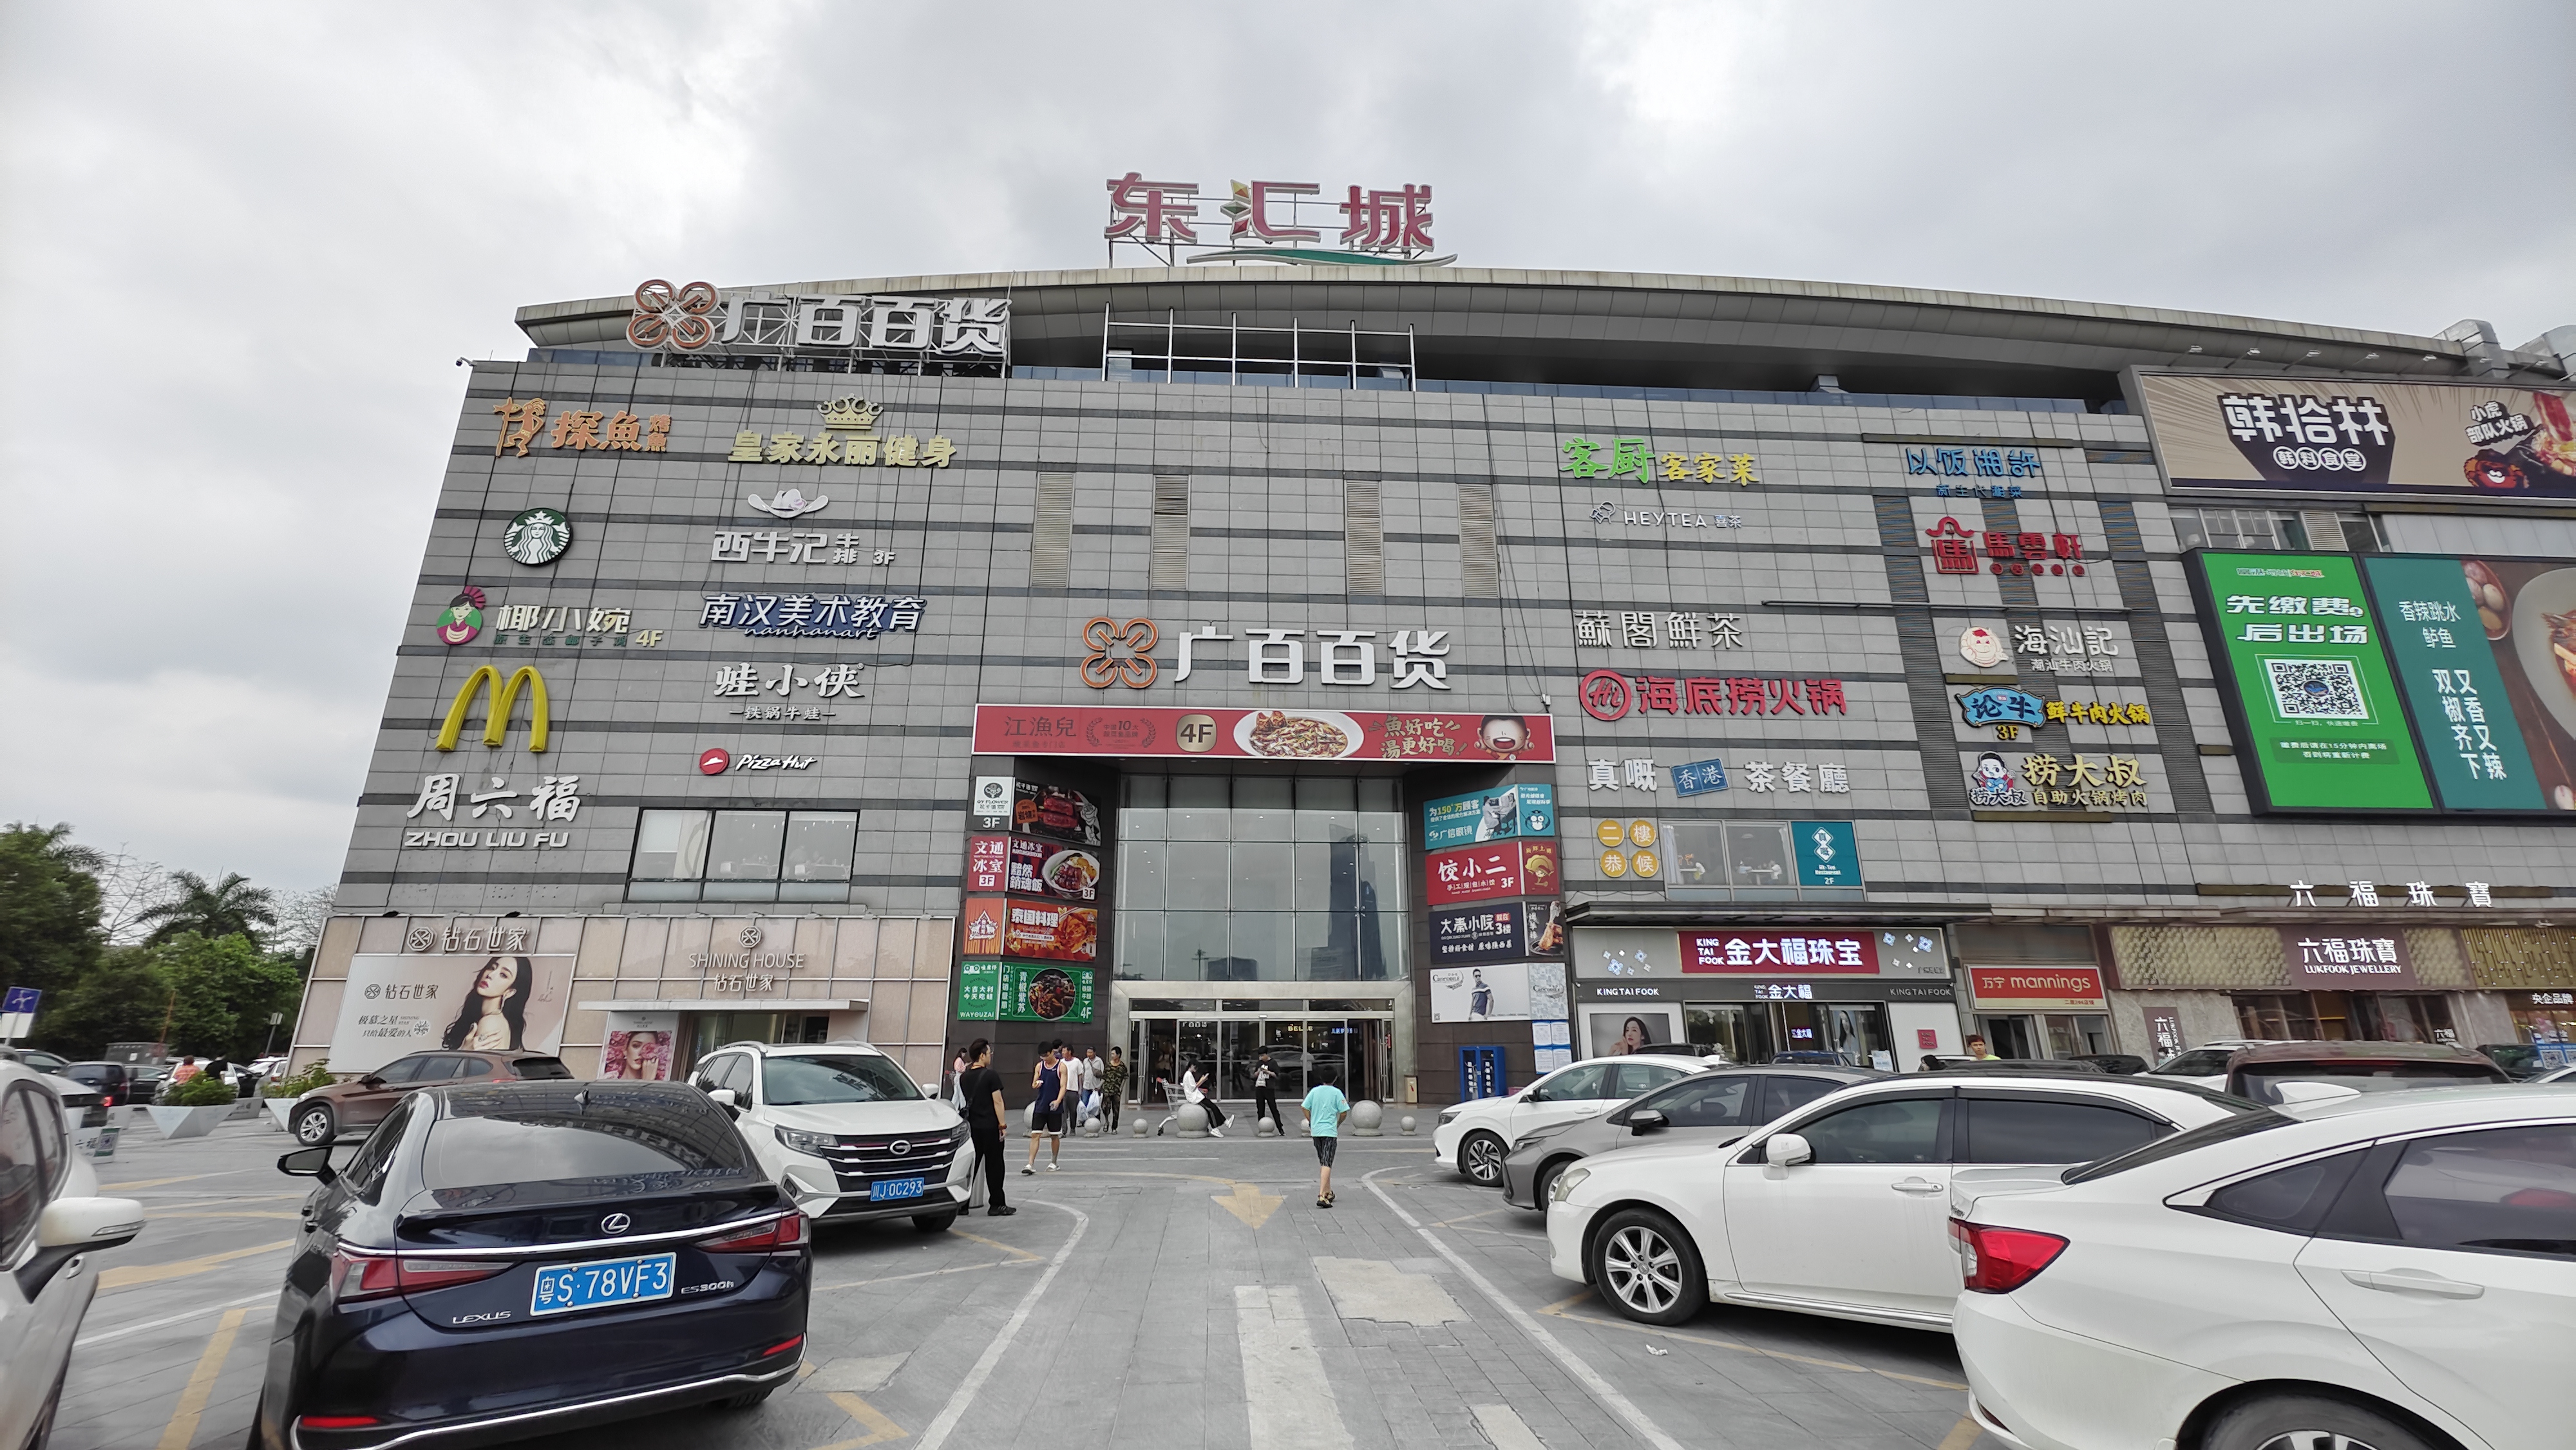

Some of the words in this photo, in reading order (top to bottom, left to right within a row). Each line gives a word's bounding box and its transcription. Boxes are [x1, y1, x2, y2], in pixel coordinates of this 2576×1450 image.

[1104, 172, 1434, 252] 东汇城
[719, 293, 1012, 356] 广百百货
[2470, 401, 2503, 422] 小虎
[551, 410, 643, 451] 探魚
[2466, 414, 2528, 444] 部队火锅
[727, 429, 957, 468] 皇家永丽健身
[1560, 437, 1656, 484] 客厨
[1659, 452, 1759, 486] 客家菜
[1624, 511, 1707, 528] HEYTEA
[1714, 514, 1743, 529] 喜茶
[711, 530, 828, 564] 西牛记
[832, 533, 860, 565] 牛排
[873, 550, 896, 566] 3F
[1982, 532, 2082, 560] 馬雲軒
[699, 593, 925, 631] 南汉美术教育
[2226, 595, 2351, 616] 先缴费
[2398, 600, 2461, 623] 香辣跳水
[635, 630, 664, 648] 4F
[744, 625, 878, 639] nanhanart
[1575, 610, 1743, 650] 蘇閣鮮茶
[2014, 625, 2119, 656] 海汕記
[2237, 623, 2369, 645] 后出场
[2421, 626, 2457, 649] 鲈鱼
[1174, 626, 1451, 690] 广百百货
[2031, 658, 2113, 673] 潮汕牛肉火锅
[714, 662, 865, 698] 蛙小侠
[1635, 676, 1847, 715] 海底捞火锅
[743, 705, 821, 720] 铁锅牛蛙
[1971, 694, 2036, 719] 论牛
[2046, 701, 2151, 725] 鲜牛肉火锅
[1180, 723, 1214, 744] 4F
[1384, 714, 1445, 738] 魚好吃
[1996, 724, 2020, 740] 3F
[2431, 668, 2481, 780] 双椒齐下
[2452, 668, 2507, 781] 又香又辣
[735, 753, 783, 771] Pizza
[781, 755, 817, 769] Hut
[2022, 753, 2148, 788] 捞大叔
[1587, 758, 1658, 793] 真嘅
[1677, 764, 1722, 791] 香港
[1744, 760, 1850, 794] 茶餐廳
[406, 773, 582, 822] 周六福
[1970, 787, 2029, 806] 捞大叔
[2033, 789, 2148, 807] 自助火锅烤肉
[982, 817, 1001, 829] 3F
[404, 831, 478, 848] ZHOU
[485, 832, 526, 848] LIU
[533, 832, 569, 848] FU
[1601, 825, 1652, 843] 二樓
[973, 858, 1003, 873] 冰室
[1437, 855, 1507, 882] 饺小二
[1604, 854, 1654, 872] 恭候
[981, 876, 993, 885] 3F
[1501, 876, 1515, 889] 3F
[1084, 889, 1095, 898] 3F
[2289, 880, 2493, 907] 六福珠寶
[1011, 908, 1059, 928] 泰国料理
[441, 926, 529, 952] 钻石世家
[1696, 937, 1719, 946] KING
[688, 952, 750, 968] SHINING
[753, 953, 807, 969] HOUSE
[1697, 948, 1714, 956] TAI
[1698, 956, 1725, 966] FOOK
[1725, 937, 1863, 966] 金大福珠宝
[2297, 937, 2398, 964] 六福珠寶
[2305, 964, 2349, 975] LUKFOOK
[2350, 965, 2402, 975] JEWELLERY
[385, 983, 439, 1000] 钻石世家
[714, 973, 774, 992] 钻石世家
[1635, 988, 1660, 996] FOOK
[1768, 984, 1814, 999] 金大福
[1982, 975, 2005, 989] 万宁
[2010, 974, 2091, 992] mannings
[2532, 993, 2573, 1005] 央企品牌
[1080, 1006, 1092, 1019] 4F
[681, 1280, 735, 1295] ES300h
[452, 1310, 512, 1325] LEXUS
